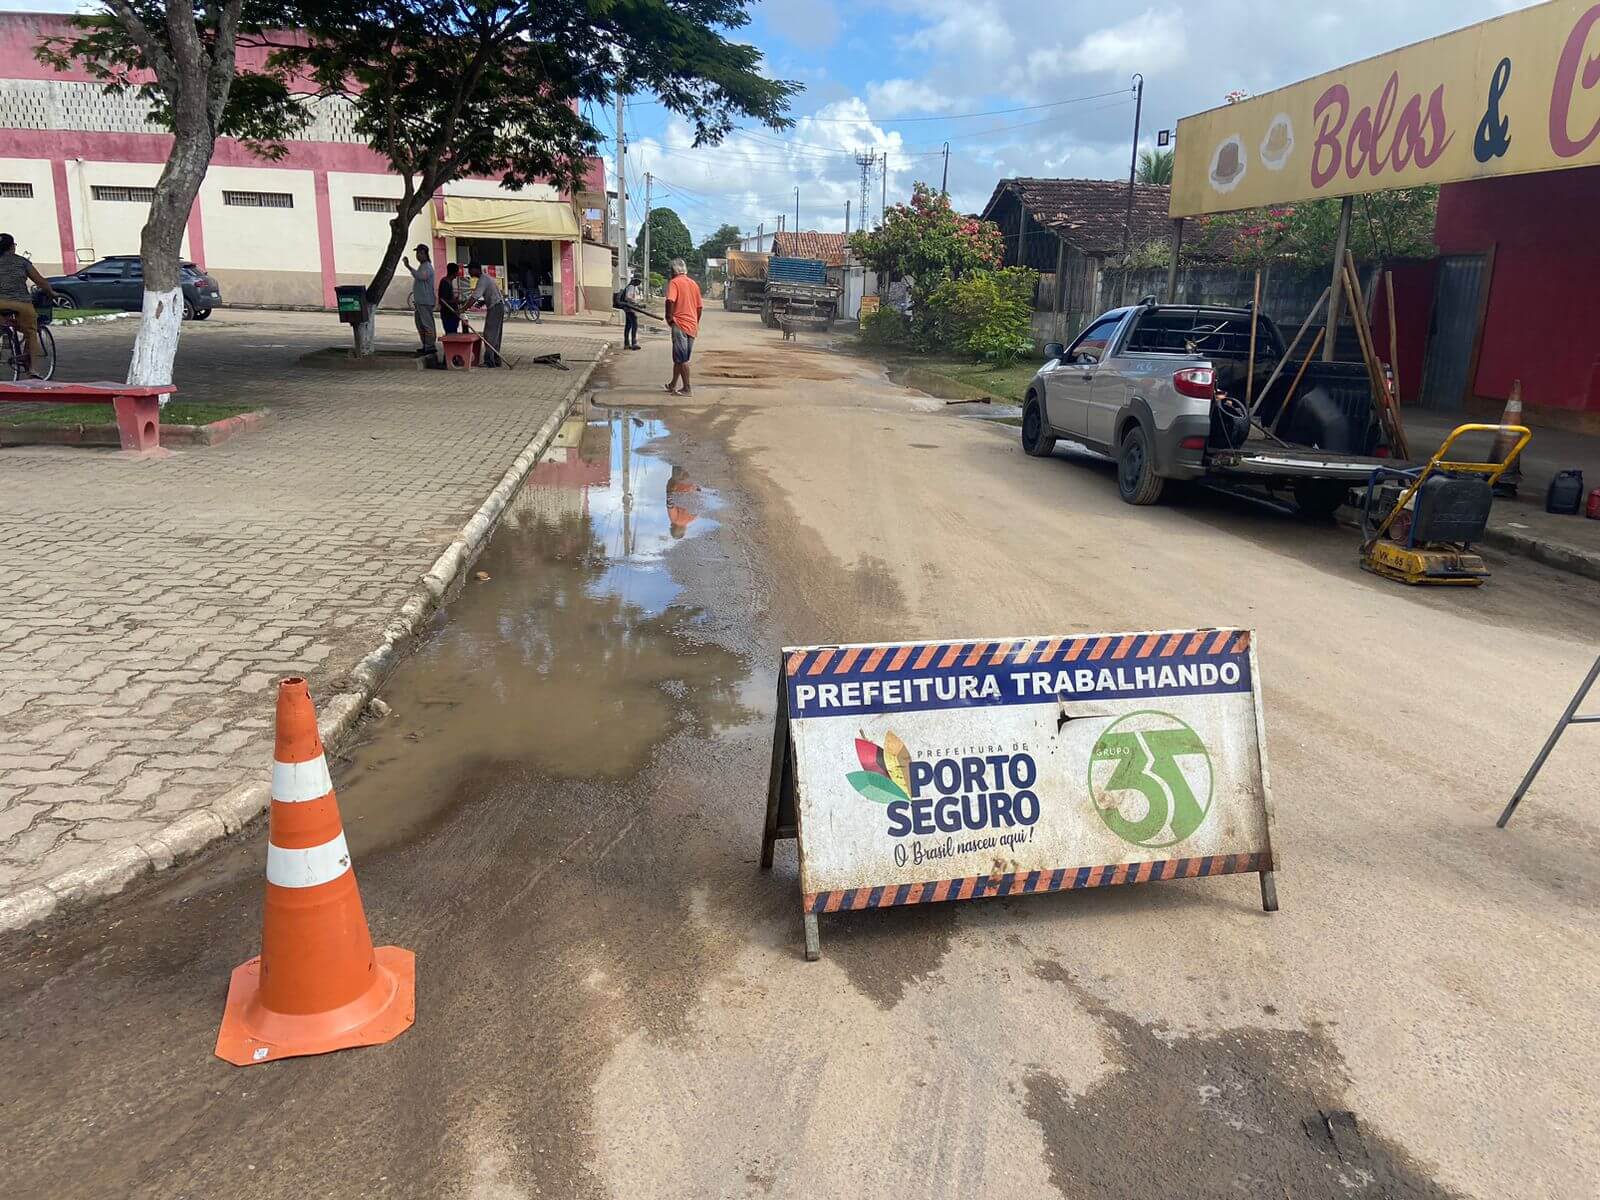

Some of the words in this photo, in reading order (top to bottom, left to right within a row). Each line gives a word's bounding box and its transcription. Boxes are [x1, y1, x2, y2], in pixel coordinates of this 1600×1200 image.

[1310, 70, 1455, 189] Bolos
[1473, 57, 1512, 163] &
[796, 673, 1001, 710] PREFEITURA
[1010, 662, 1241, 696] TRABALHANDO
[917, 744, 1003, 759] PREFEITURA
[1012, 742, 1029, 752] DE
[1096, 746, 1130, 757] GRUPO
[908, 752, 1037, 798] PORTO
[886, 790, 1041, 837] SEGURO
[894, 843, 909, 868] O
[911, 837, 955, 866] Brasil
[957, 837, 998, 854] nasceu
